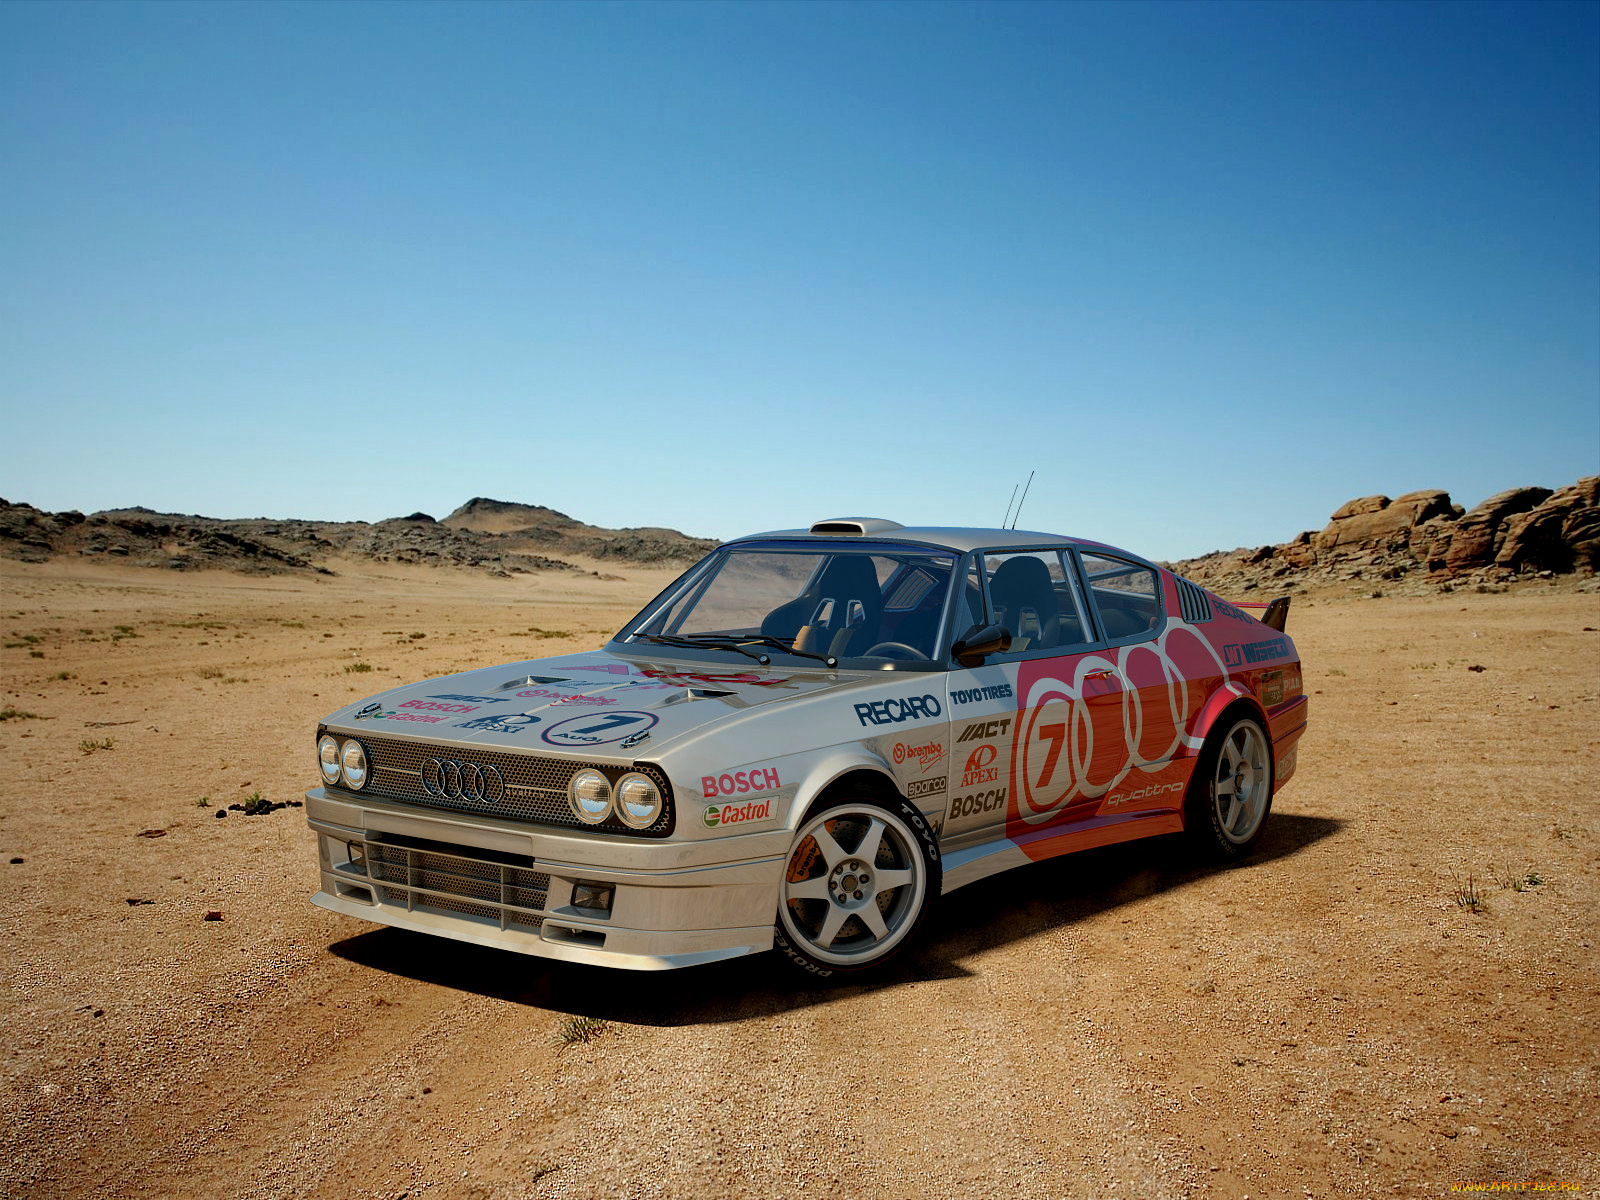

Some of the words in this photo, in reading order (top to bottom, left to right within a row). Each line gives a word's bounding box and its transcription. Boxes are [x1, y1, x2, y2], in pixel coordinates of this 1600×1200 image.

[398, 699, 481, 714] BOSCH
[853, 693, 942, 727] RECARO
[551, 732, 606, 743] Audi
[907, 740, 942, 759] brembo
[1035, 722, 1066, 789] 7
[701, 767, 781, 798] BOSCH
[908, 777, 946, 799] sparco
[1107, 781, 1184, 807] quattro
[720, 799, 770, 824] Castrol
[949, 787, 1007, 820] BOSCH
[901, 803, 938, 861] TOYO
